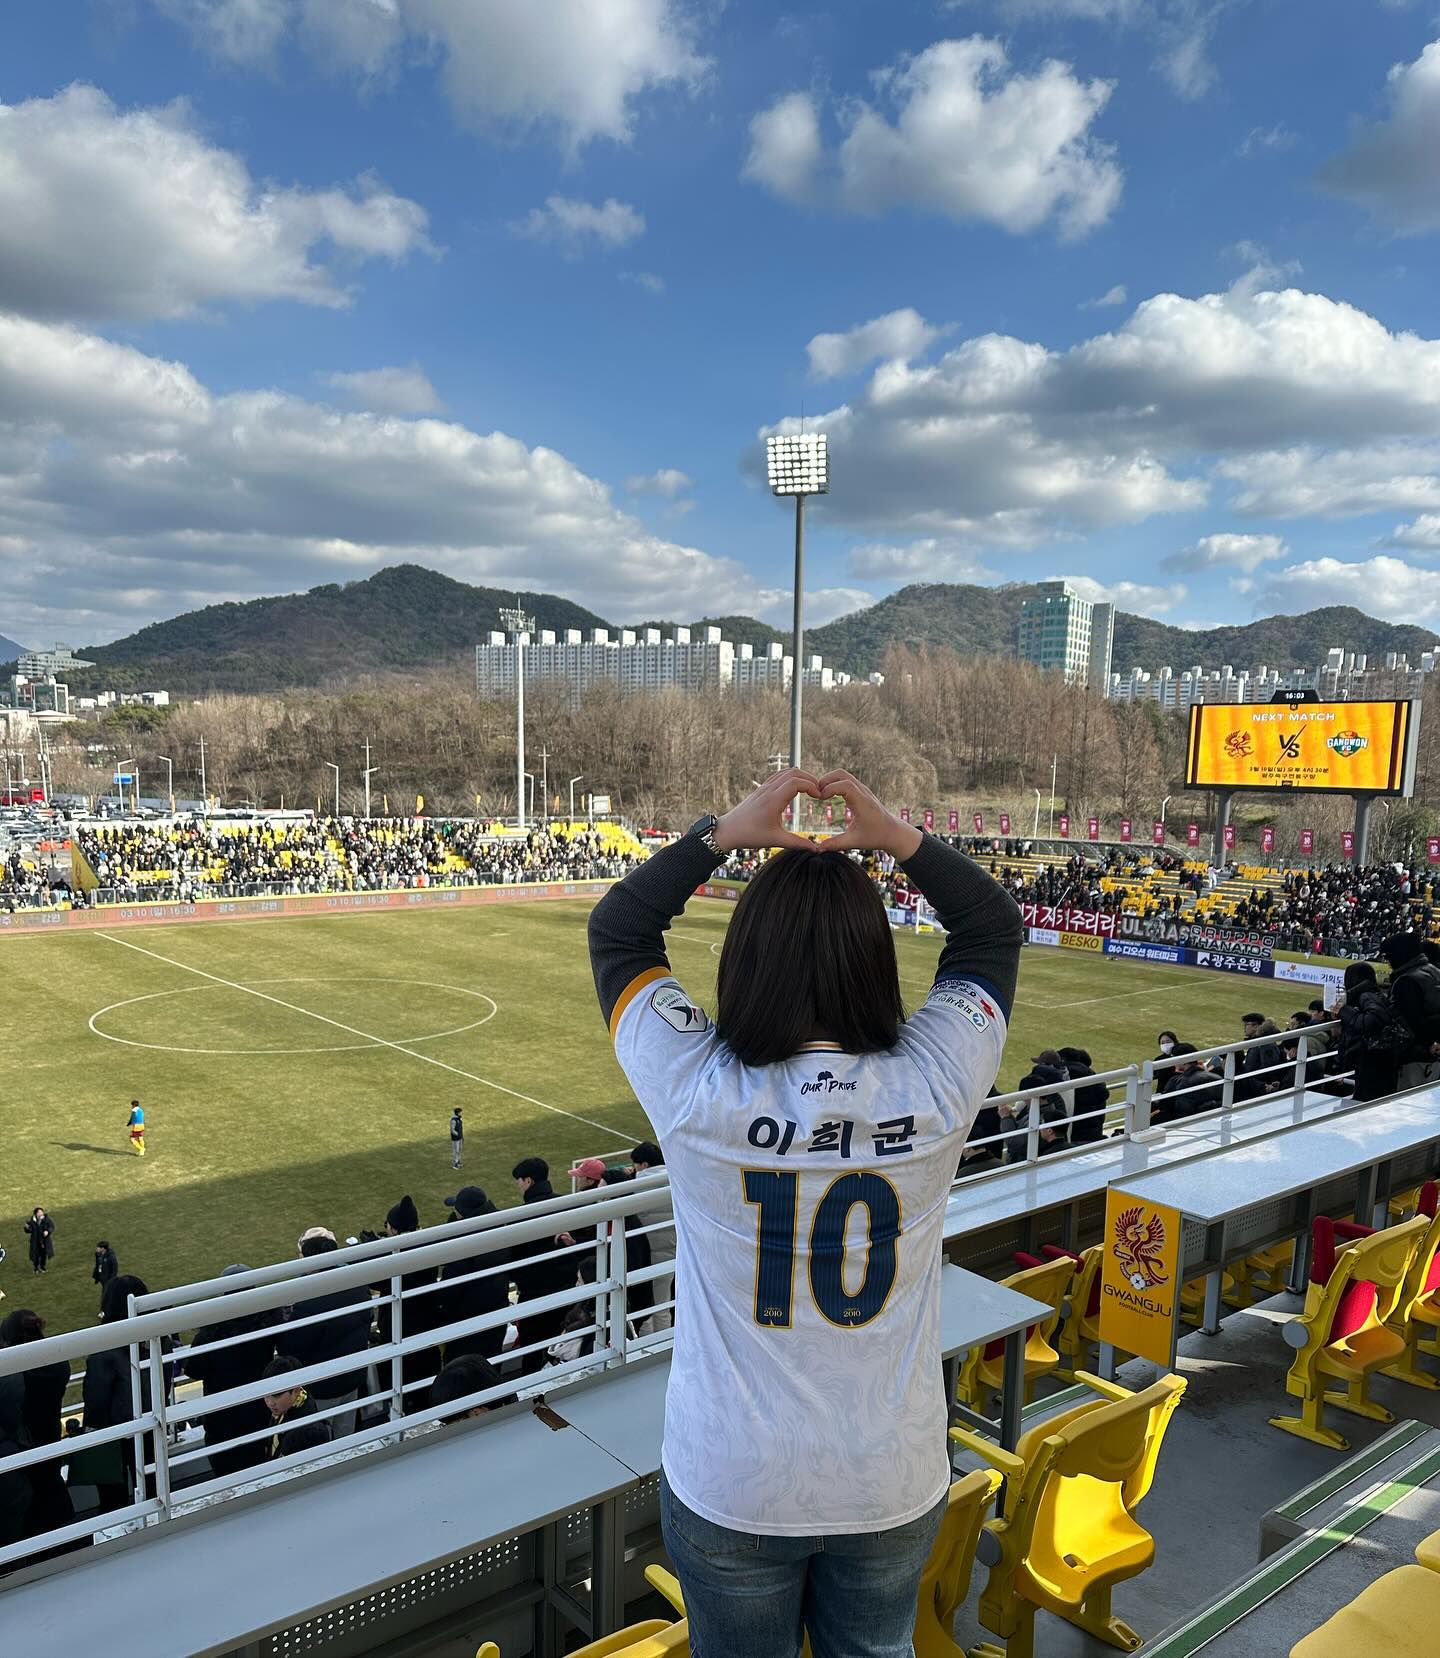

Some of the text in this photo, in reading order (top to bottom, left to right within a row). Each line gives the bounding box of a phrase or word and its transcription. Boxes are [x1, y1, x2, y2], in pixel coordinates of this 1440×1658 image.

[1061, 934, 1100, 949] BESKO
[1191, 925, 1276, 948] GRUPPO
[1212, 954, 1262, 973] 광주은행
[801, 1080, 857, 1095] OUR PRIDE
[748, 1115, 918, 1158] 이희균
[740, 1168, 903, 1329] 10
[1104, 1284, 1171, 1316] GWANGJU
[1119, 1302, 1141, 1314] FOOTBALL
[764, 1309, 782, 1317] 2010
